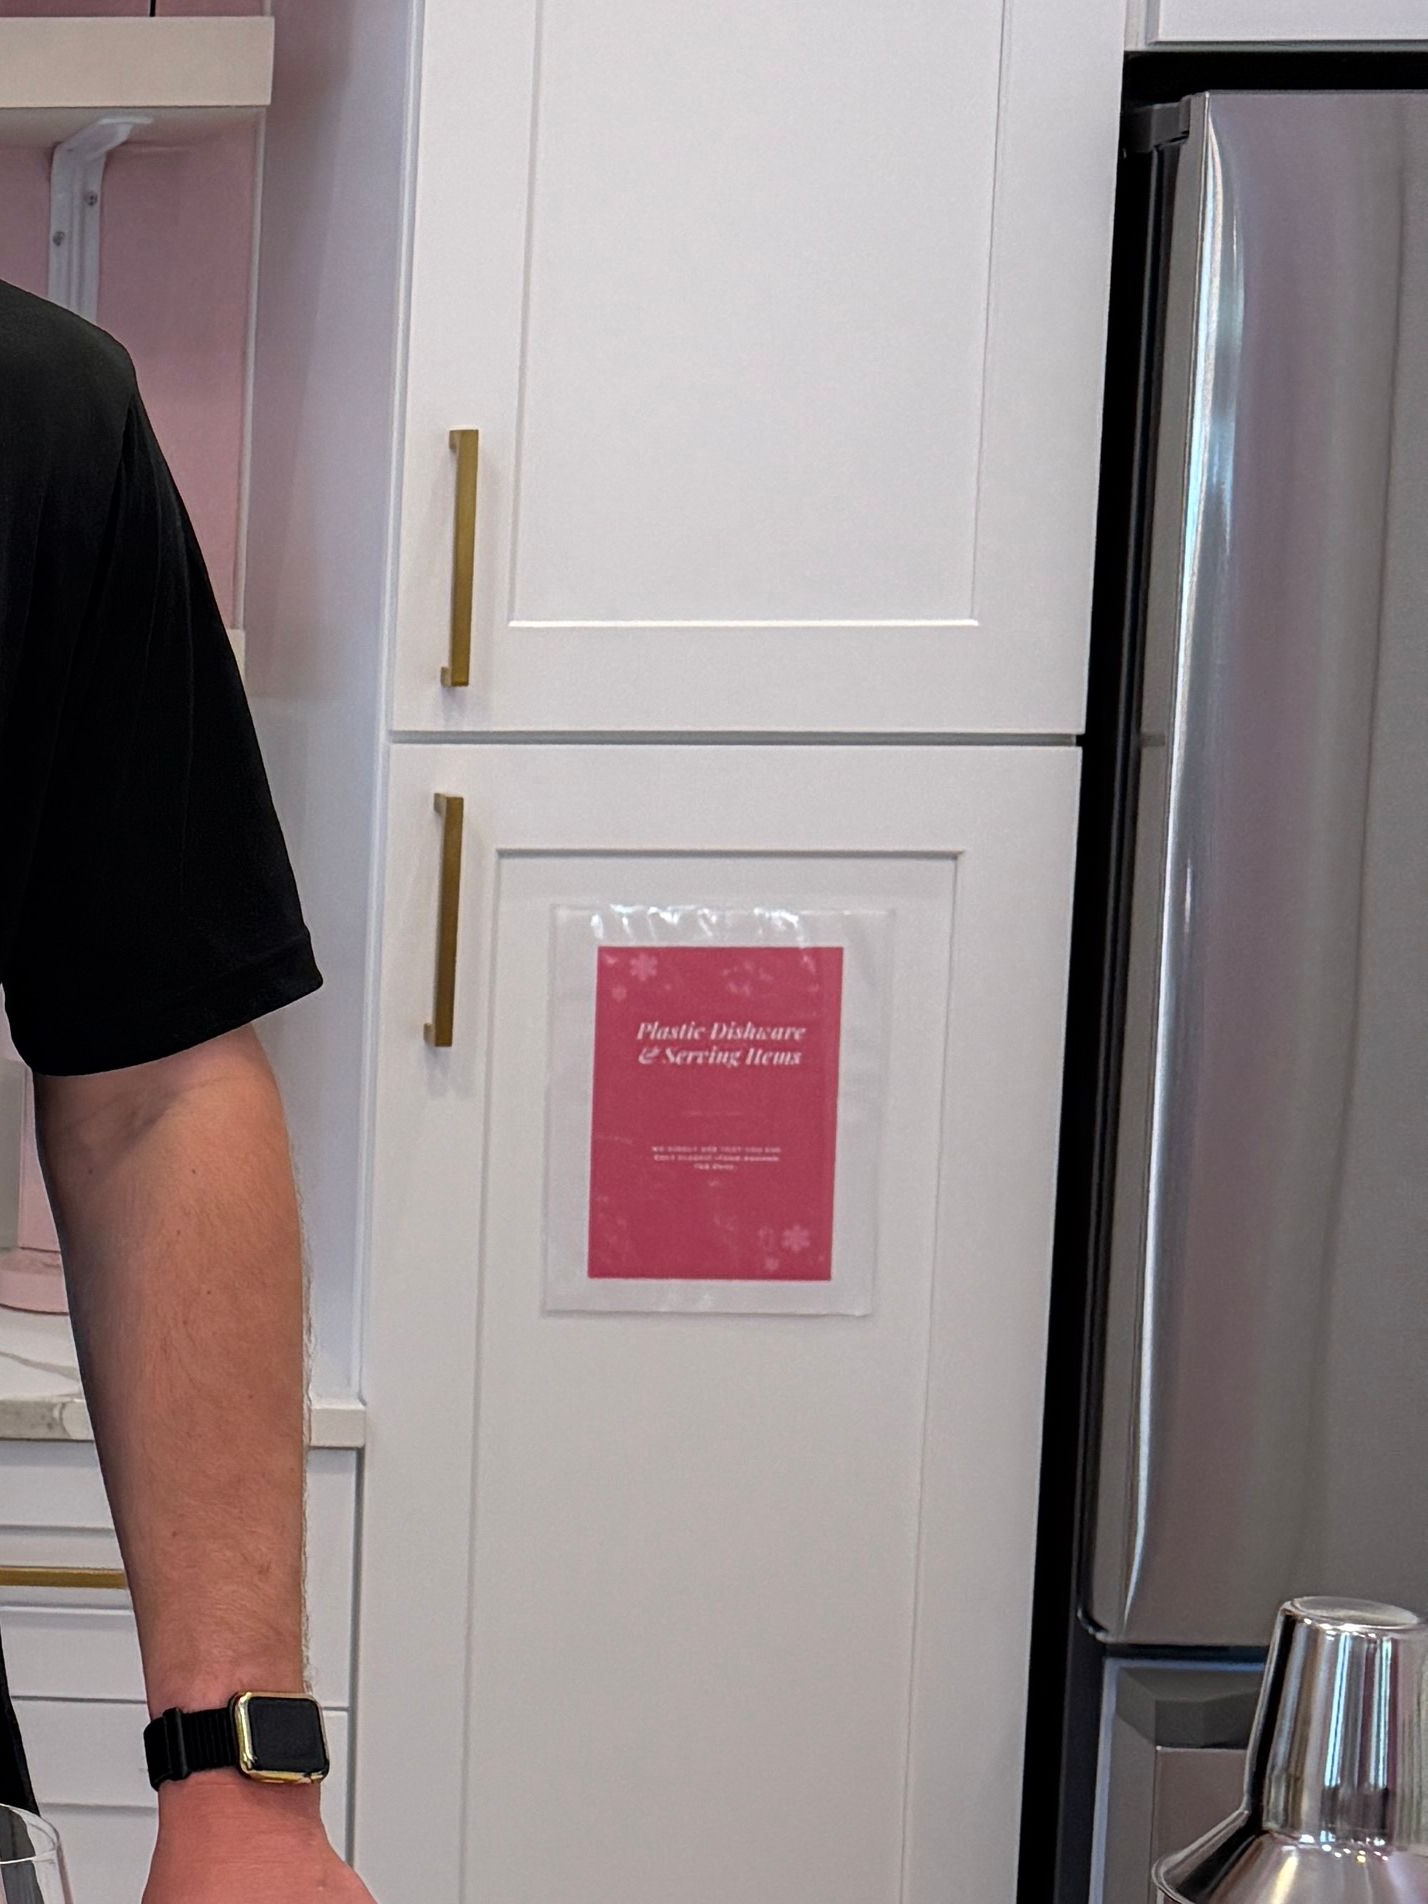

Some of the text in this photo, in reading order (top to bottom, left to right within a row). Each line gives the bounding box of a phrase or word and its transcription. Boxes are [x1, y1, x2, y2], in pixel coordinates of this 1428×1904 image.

[637, 1021, 807, 1040] Plastic Dishware
[638, 1046, 802, 1067] & Serving Items
